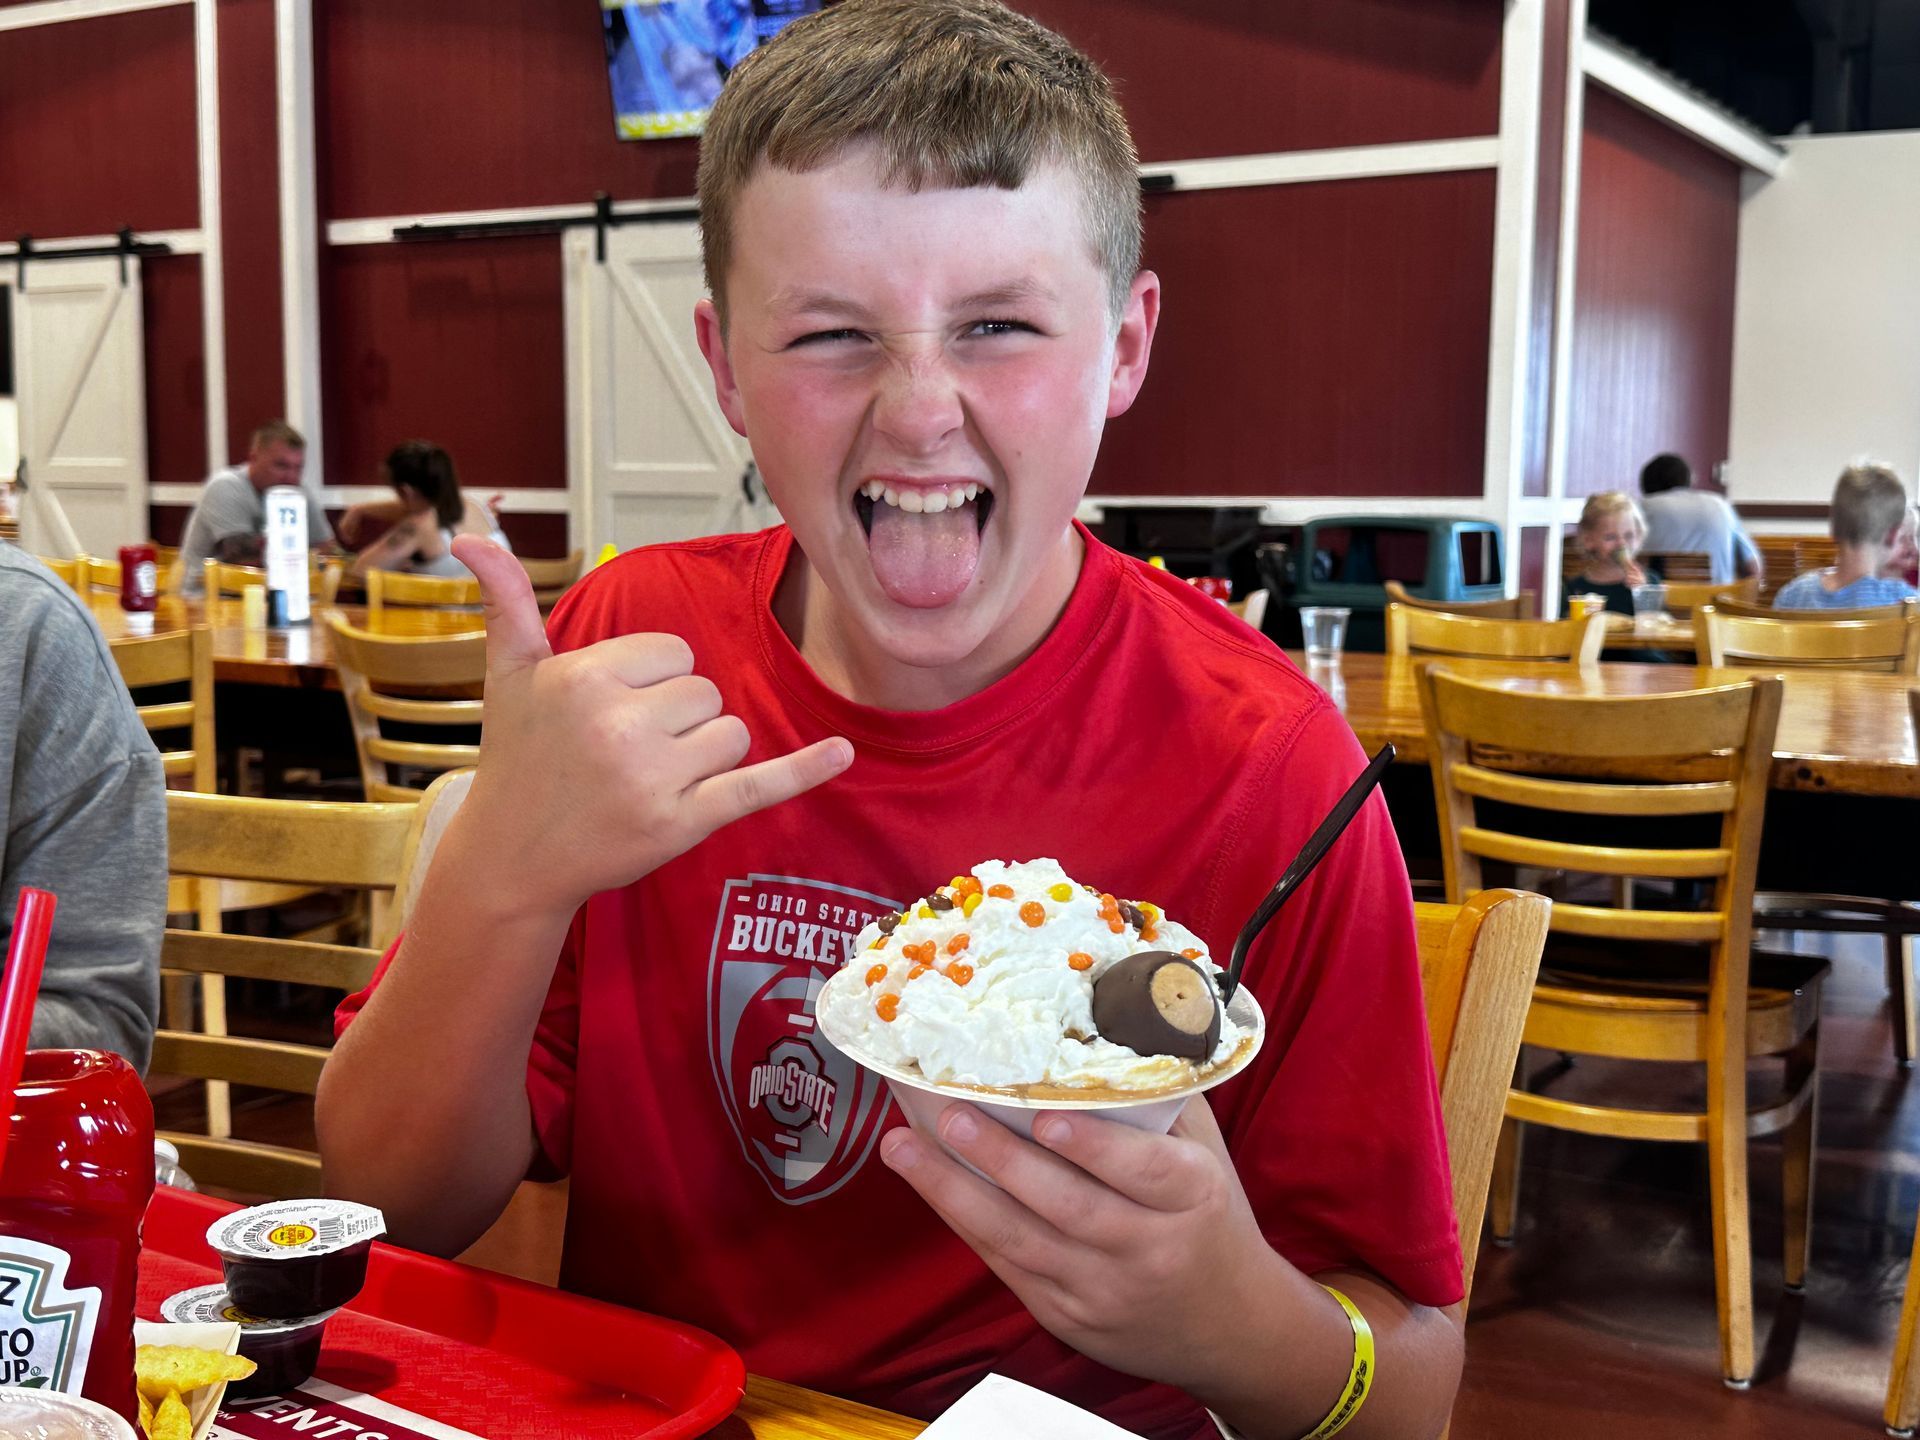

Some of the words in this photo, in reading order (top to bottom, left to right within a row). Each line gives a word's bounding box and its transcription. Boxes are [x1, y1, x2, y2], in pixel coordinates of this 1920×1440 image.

[757, 893, 806, 916] OHIO
[818, 903, 881, 929] STAT
[749, 1064, 786, 1109] OHIO
[785, 1062, 836, 1134] STATE
